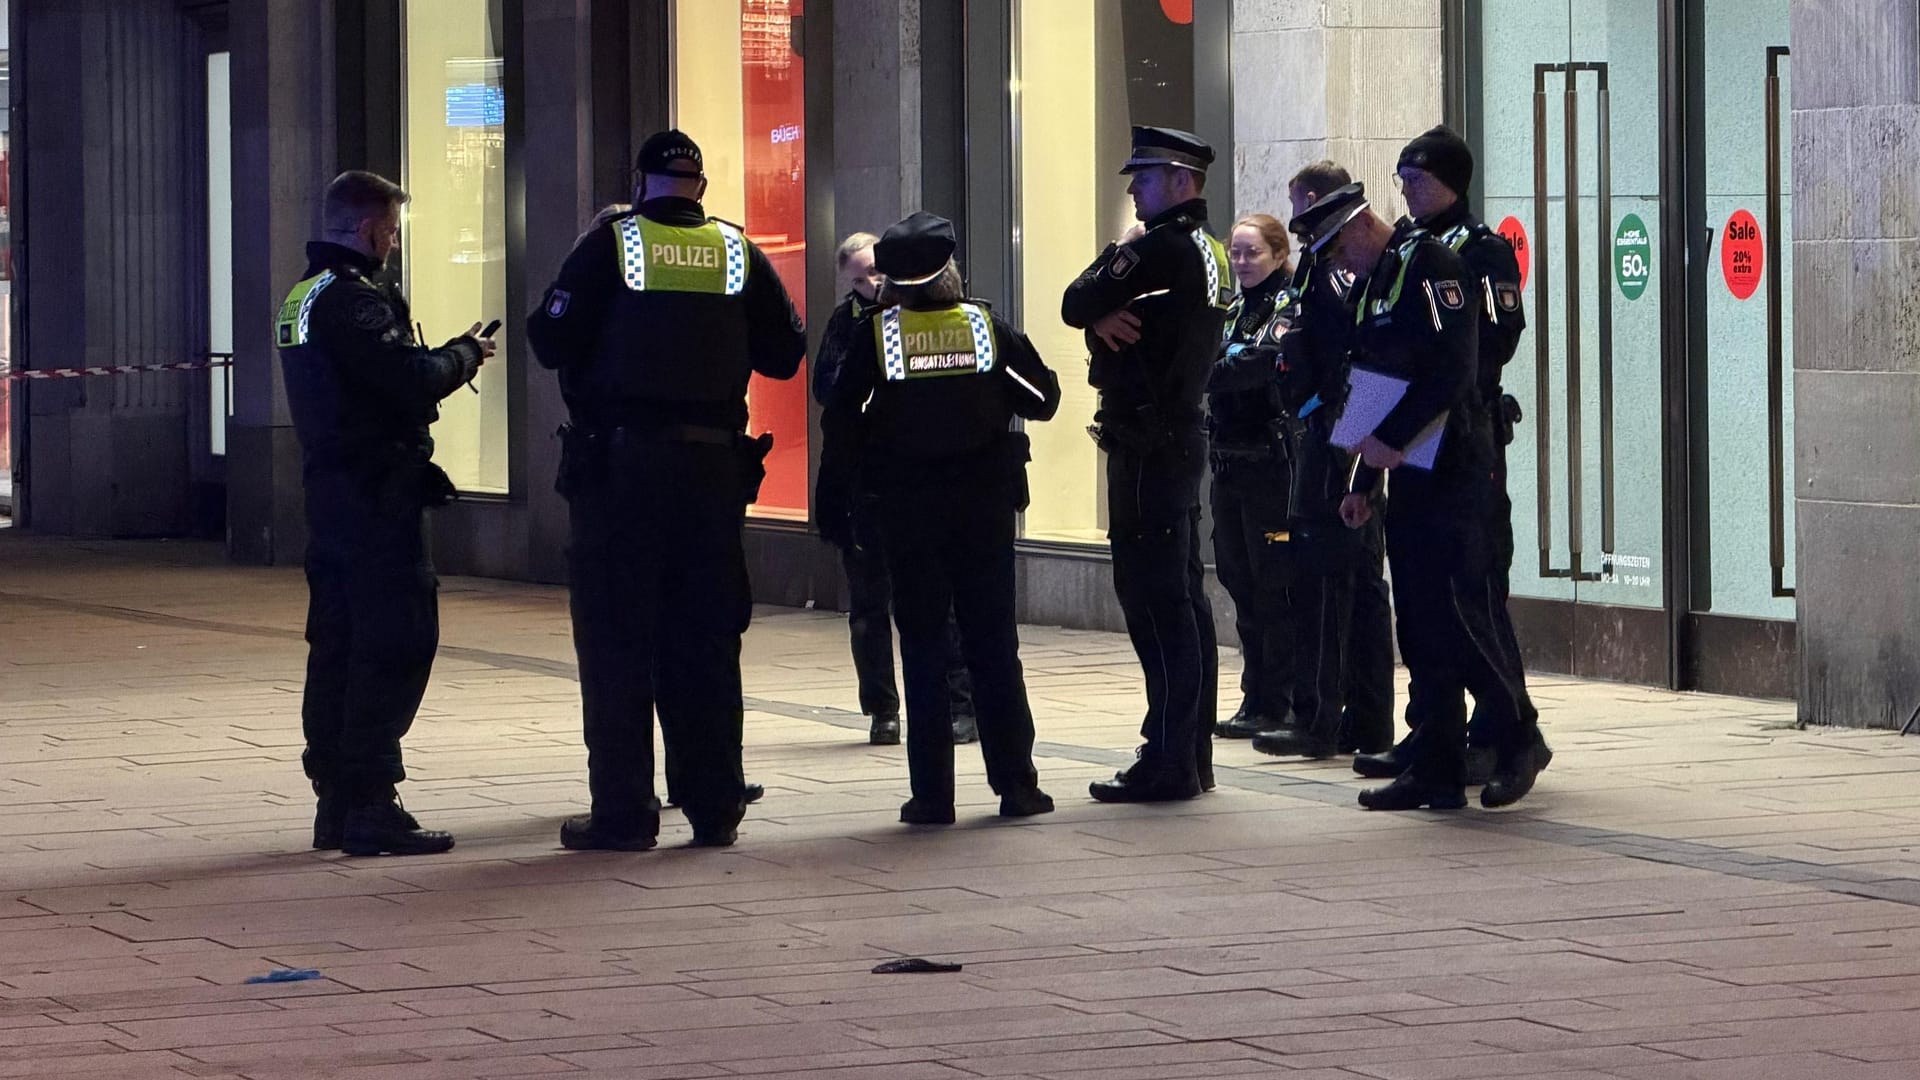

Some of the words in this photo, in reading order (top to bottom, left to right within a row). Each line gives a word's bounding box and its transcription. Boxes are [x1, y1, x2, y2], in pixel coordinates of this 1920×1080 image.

[1729, 221, 1755, 240] Sale
[651, 243, 719, 268] POLIZEI
[1733, 250, 1752, 264] 20%
[1622, 254, 1648, 277] 50%
[1733, 264, 1752, 274] extra
[905, 328, 971, 354] POLIZEI
[909, 352, 975, 371] EINSATZLEITUNG
